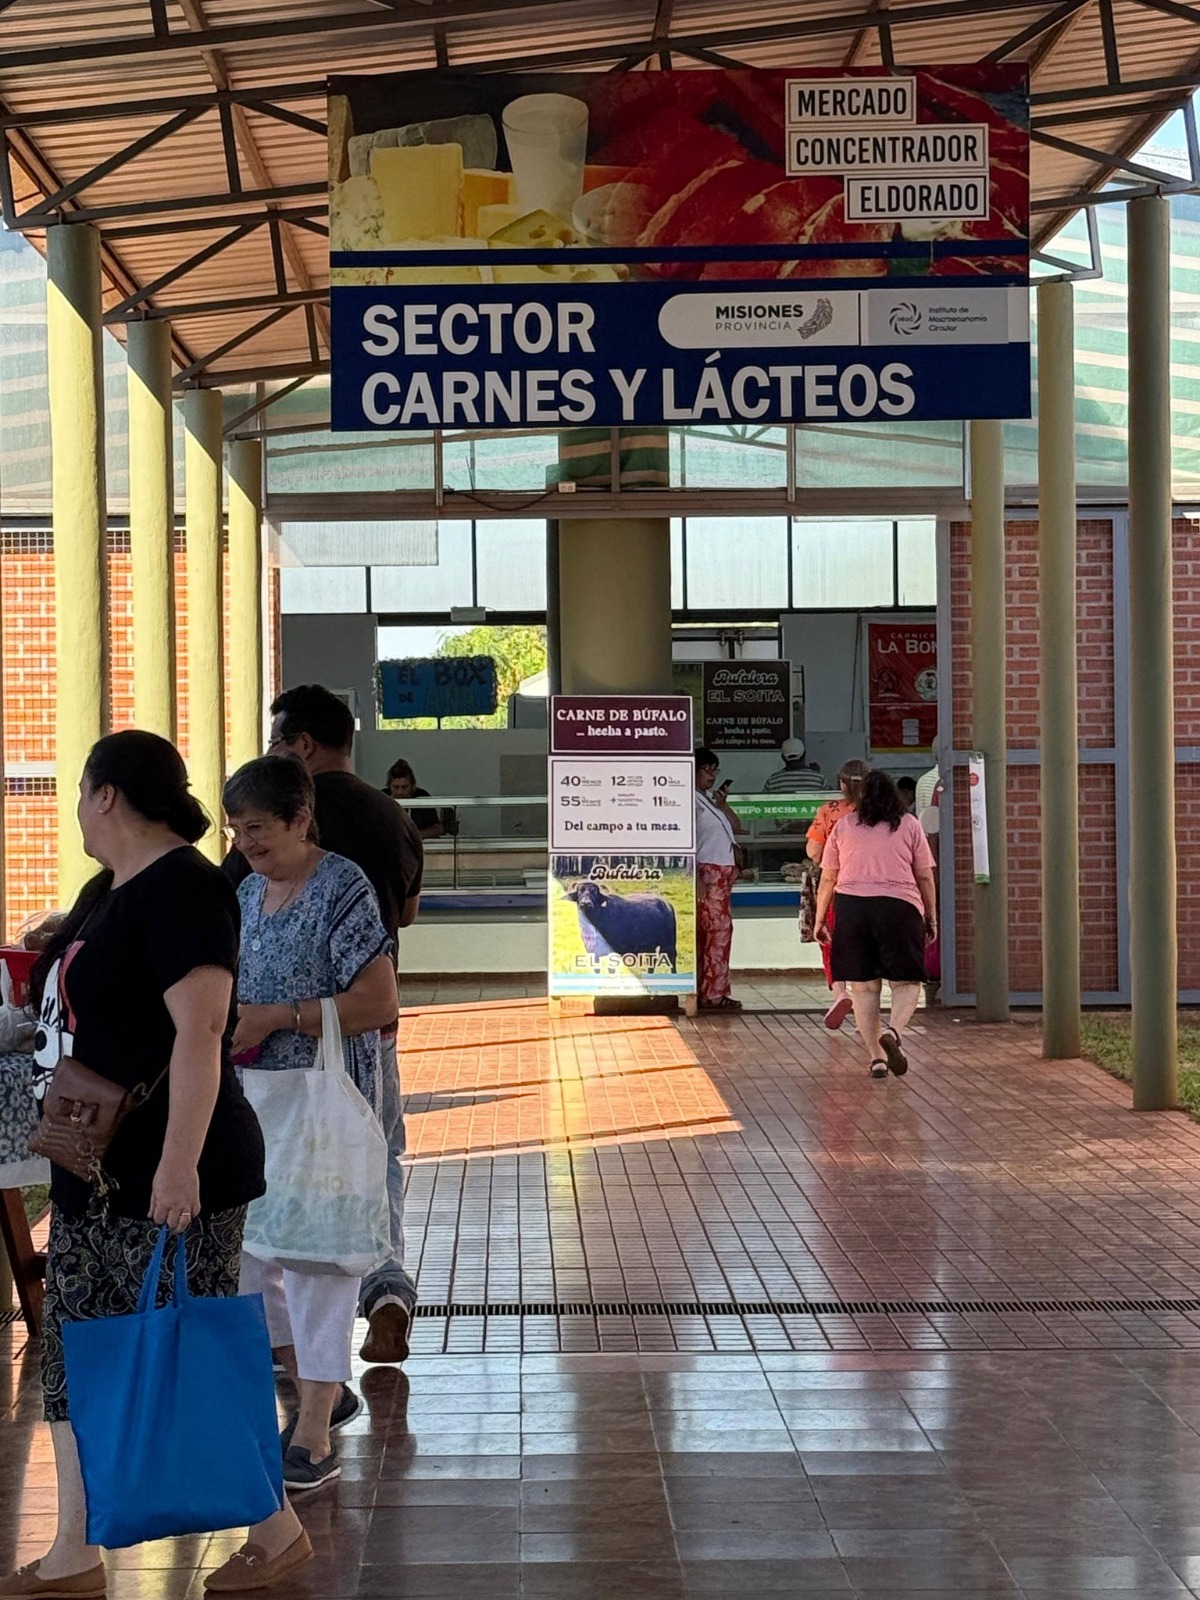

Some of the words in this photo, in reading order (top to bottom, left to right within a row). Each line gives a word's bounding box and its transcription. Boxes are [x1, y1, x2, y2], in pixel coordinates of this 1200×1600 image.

[797, 87, 908, 118] MERCADO
[795, 134, 979, 166] CONCENTRADOR
[859, 182, 979, 214] ELDORADO
[715, 303, 804, 321] MISIONES
[362, 301, 597, 357] SECTOR
[715, 319, 794, 332] PROVINCIA
[361, 370, 597, 426] CARNES
[609, 368, 647, 422] Y
[662, 351, 917, 420] LÁCTEOS
[877, 639, 899, 654] LA
[398, 665, 420, 687] EL
[434, 661, 488, 687] BOX
[713, 669, 780, 687] Bufalera
[707, 689, 731, 703] EL
[733, 689, 786, 703] SOITA
[556, 709, 605, 721] CARNE
[609, 709, 629, 721] DE
[632, 707, 688, 721] BÚFALO
[706, 717, 735, 725] CARNE
[737, 717, 749, 725] DE
[587, 725, 622, 737] hecha
[624, 728, 632, 737] a
[634, 725, 669, 739] pasto.
[724, 727, 745, 735] hecha
[560, 775, 581, 787] 40
[611, 775, 626, 787] 12
[652, 775, 667, 787] 10
[560, 796, 581, 807] 55
[652, 796, 663, 807] 11
[763, 806, 798, 814] HECHA
[800, 806, 808, 814] A
[564, 820, 584, 831] Del
[586, 822, 624, 833] campo
[626, 822, 633, 831] a
[636, 821, 648, 831] tu
[651, 822, 681, 831] mesa.
[589, 864, 663, 882] Bufalera
[575, 953, 600, 968] EL
[608, 953, 673, 968] SOITA
